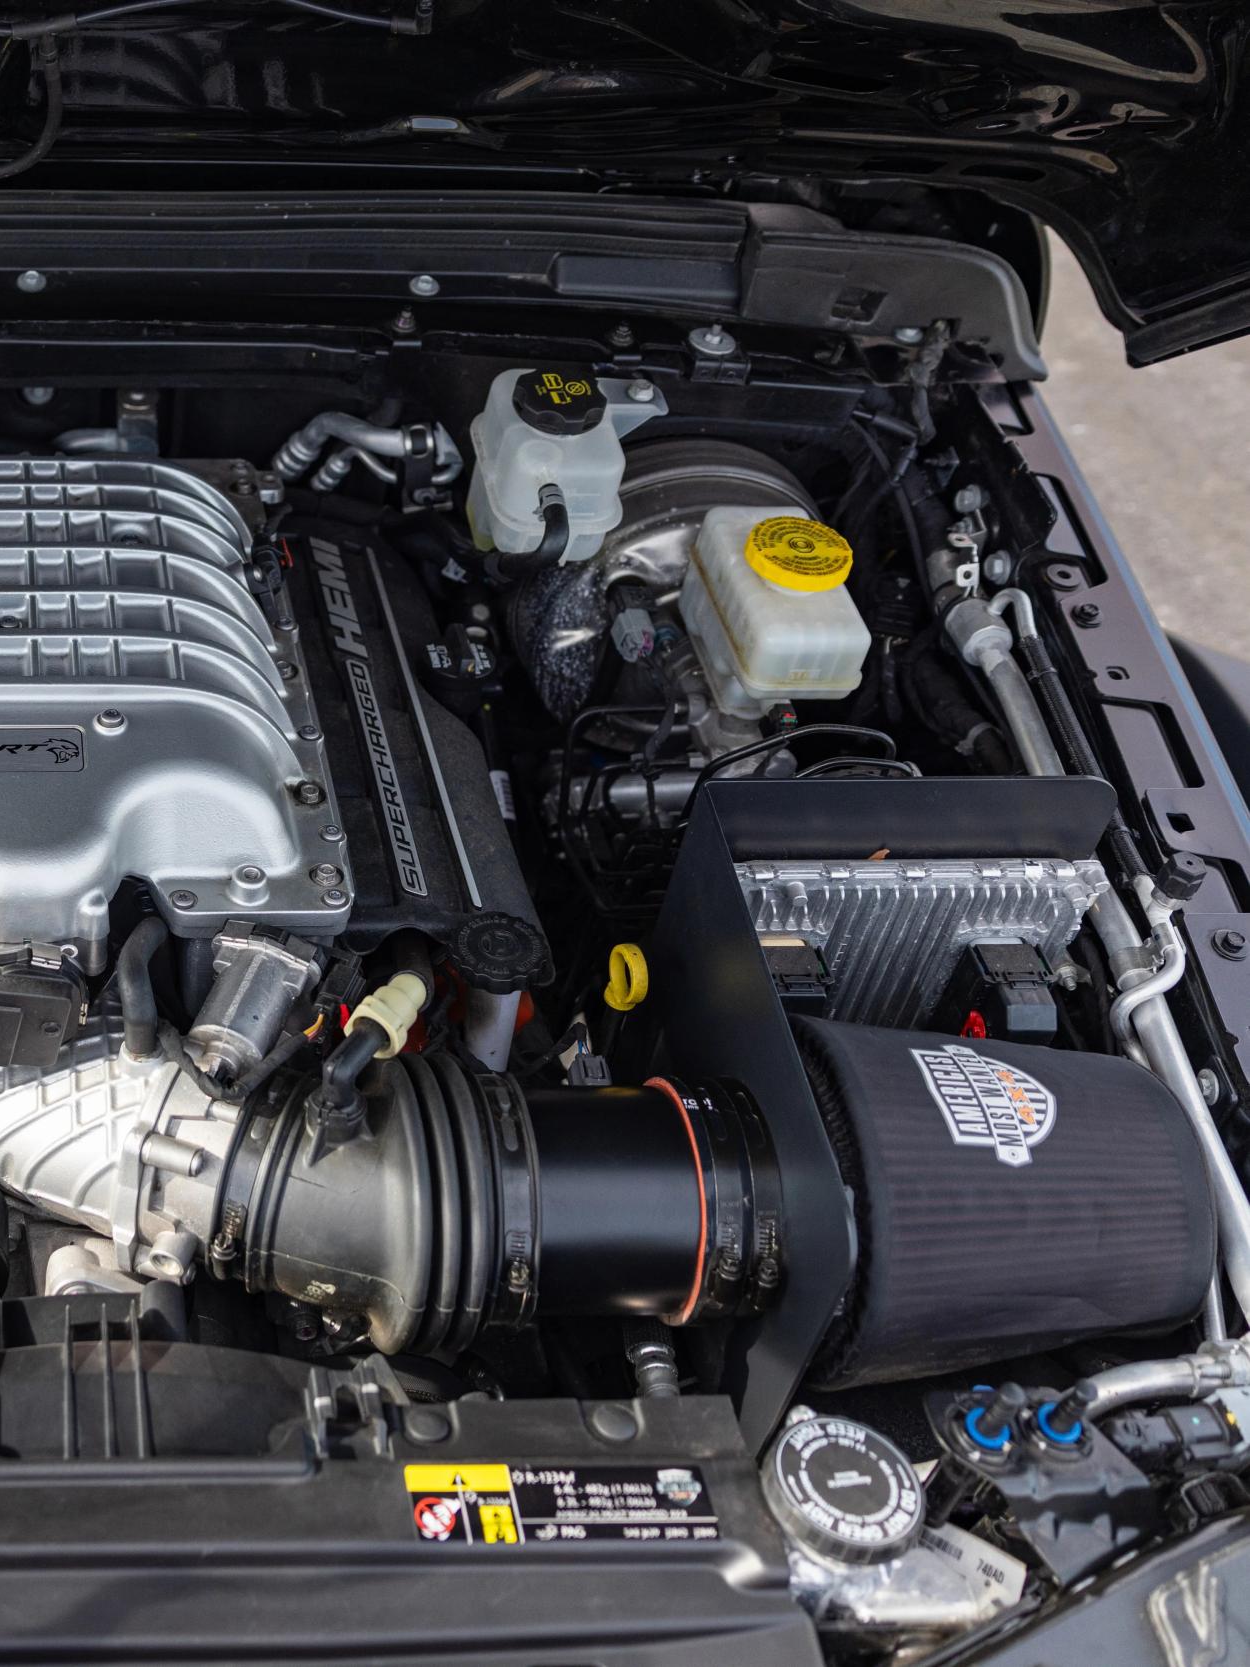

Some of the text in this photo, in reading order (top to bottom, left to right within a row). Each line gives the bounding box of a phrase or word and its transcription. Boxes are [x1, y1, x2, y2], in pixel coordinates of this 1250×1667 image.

[309, 536, 368, 658] HEMI
[349, 661, 425, 892] SUPERCHARGED
[924, 1056, 990, 1134] AMERICAS
[953, 1053, 1024, 1147] MOST WANTED
[826, 1422, 866, 1442] KEEP
